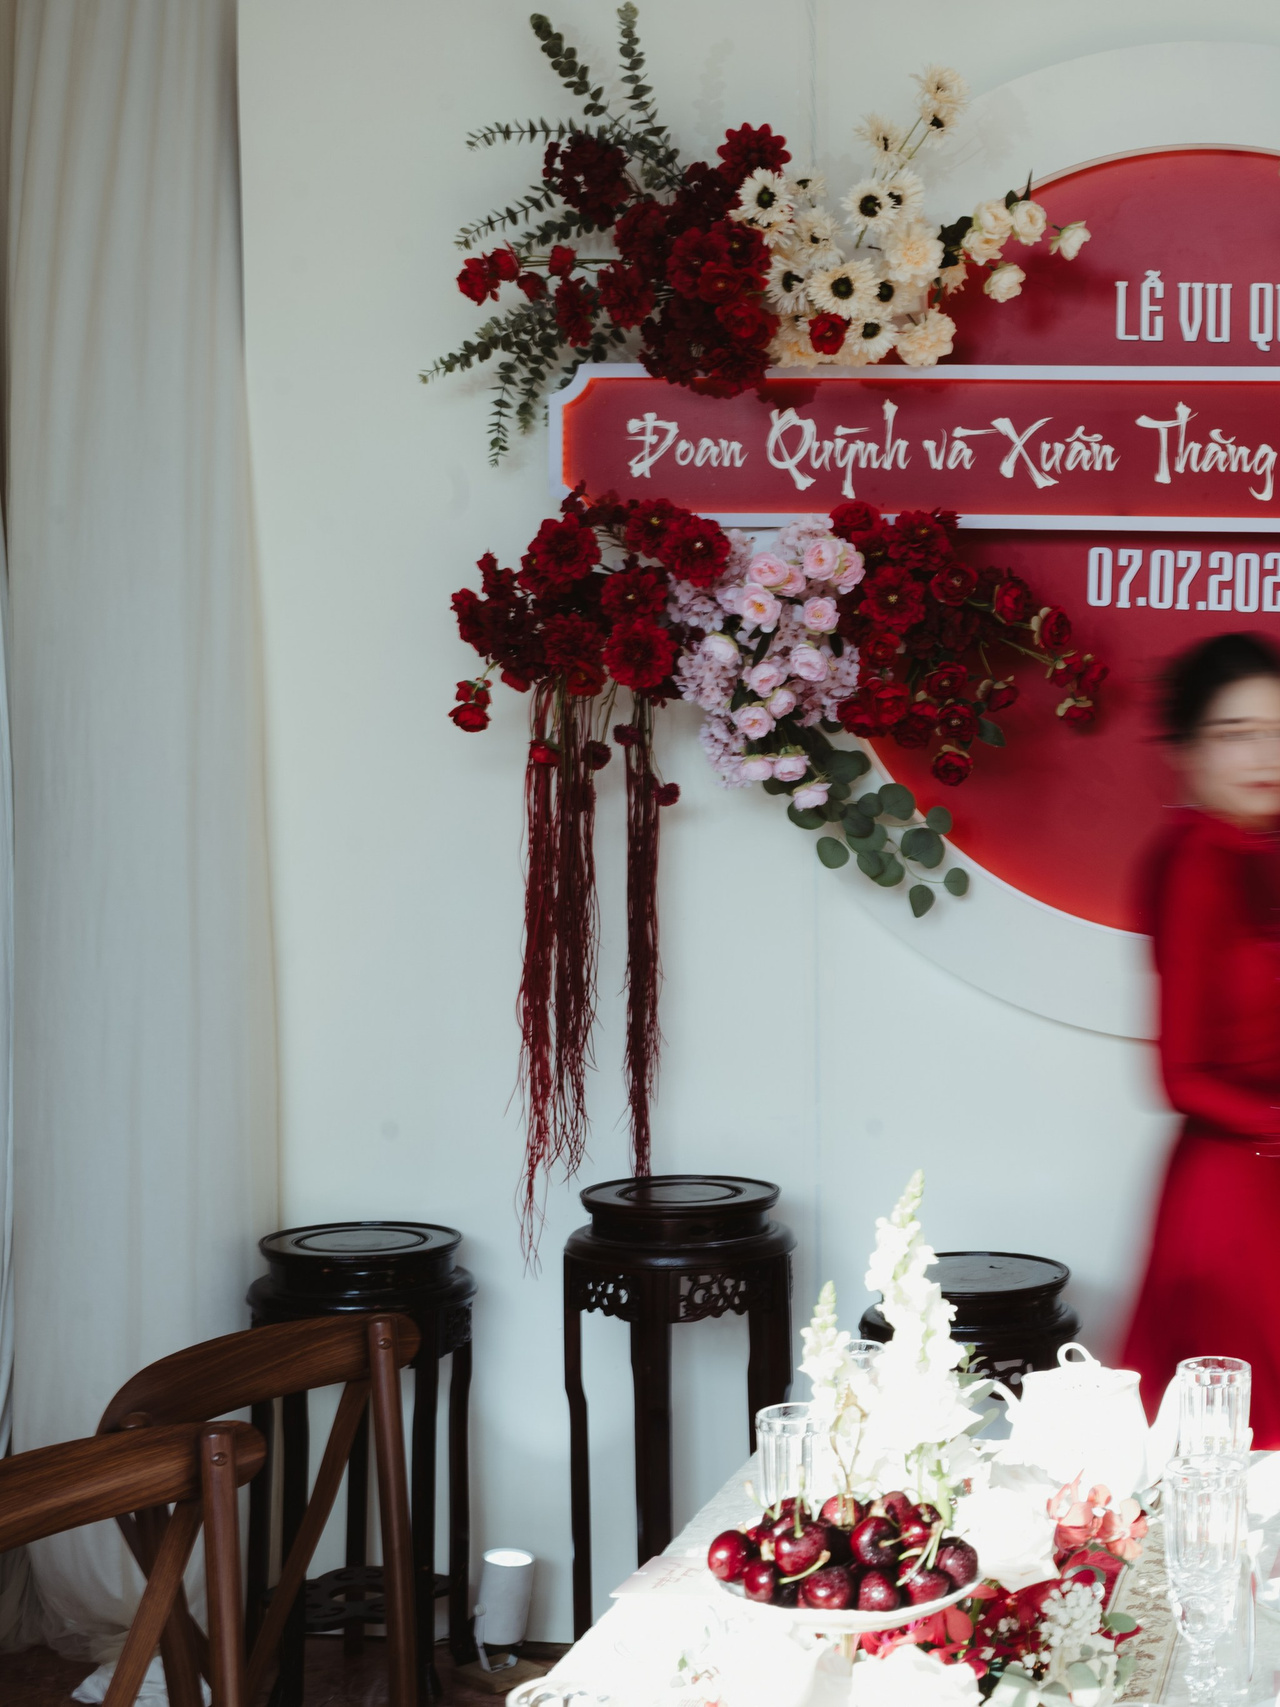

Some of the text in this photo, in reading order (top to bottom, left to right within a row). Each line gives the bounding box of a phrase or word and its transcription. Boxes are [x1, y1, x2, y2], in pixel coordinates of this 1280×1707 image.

[1115, 269, 1165, 342] LỄ
[1177, 281, 1233, 343] VU
[626, 411, 748, 479] Đoan
[991, 416, 1121, 489] Xuân
